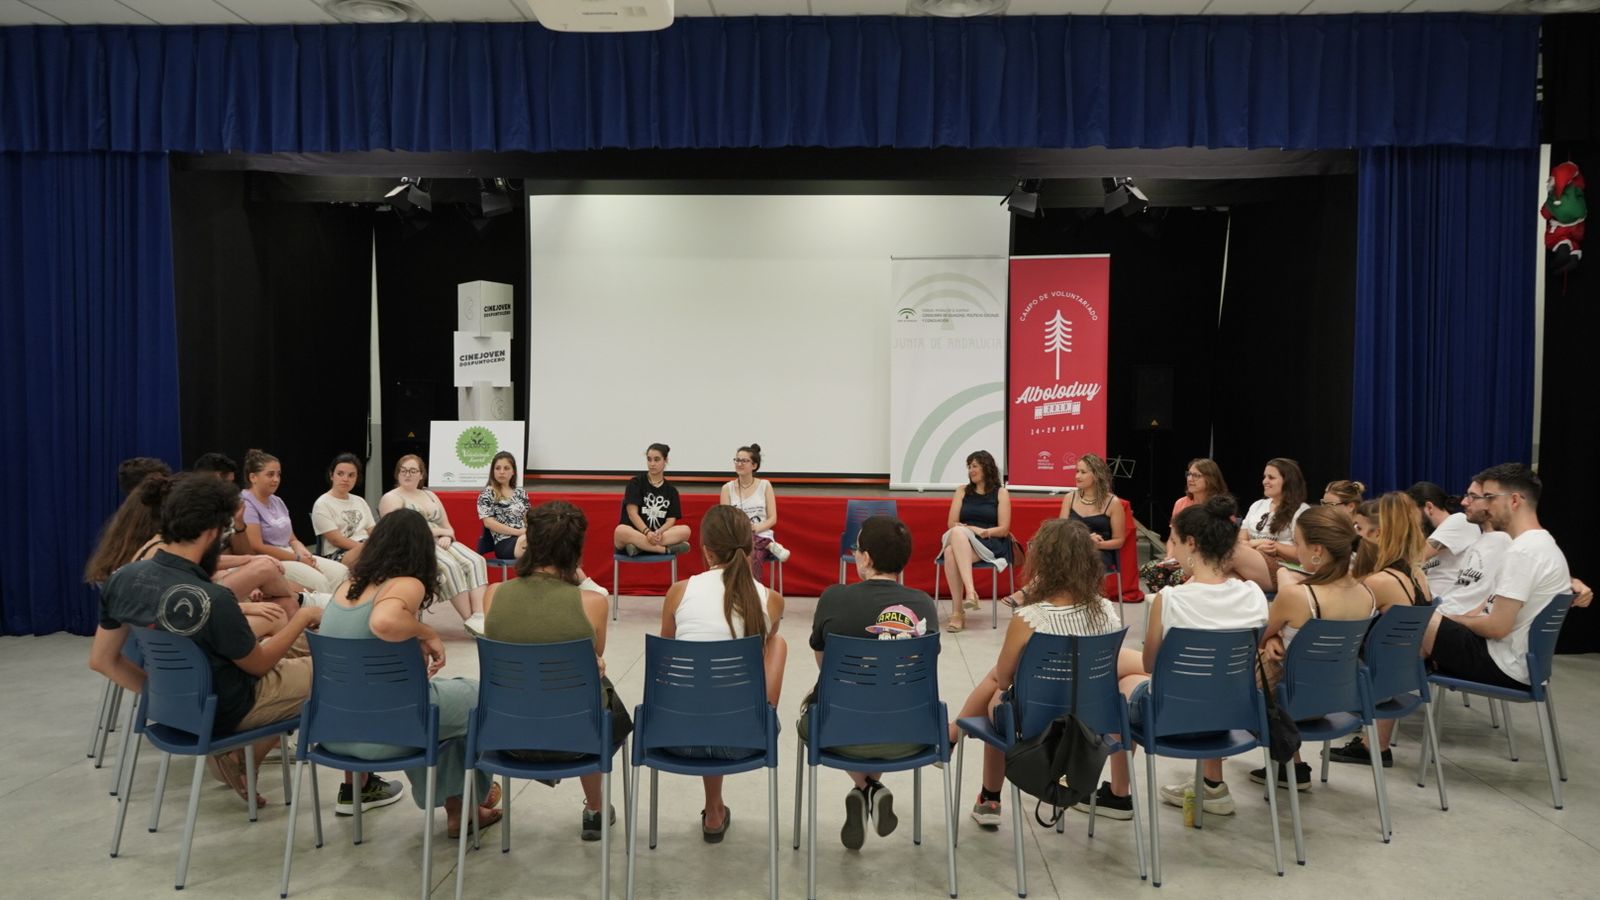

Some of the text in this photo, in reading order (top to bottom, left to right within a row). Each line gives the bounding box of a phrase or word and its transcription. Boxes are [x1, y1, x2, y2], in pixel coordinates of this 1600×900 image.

[483, 303, 511, 313] CINEJOVEN
[1020, 290, 1098, 321] CAMPO DE VOLUNTARIADO
[459, 350, 506, 362] CINEJOVEN
[459, 357, 506, 368] DOSPUNTOCERO
[1015, 381, 1101, 404] Alboloduy
[878, 612, 910, 625] ARALE
